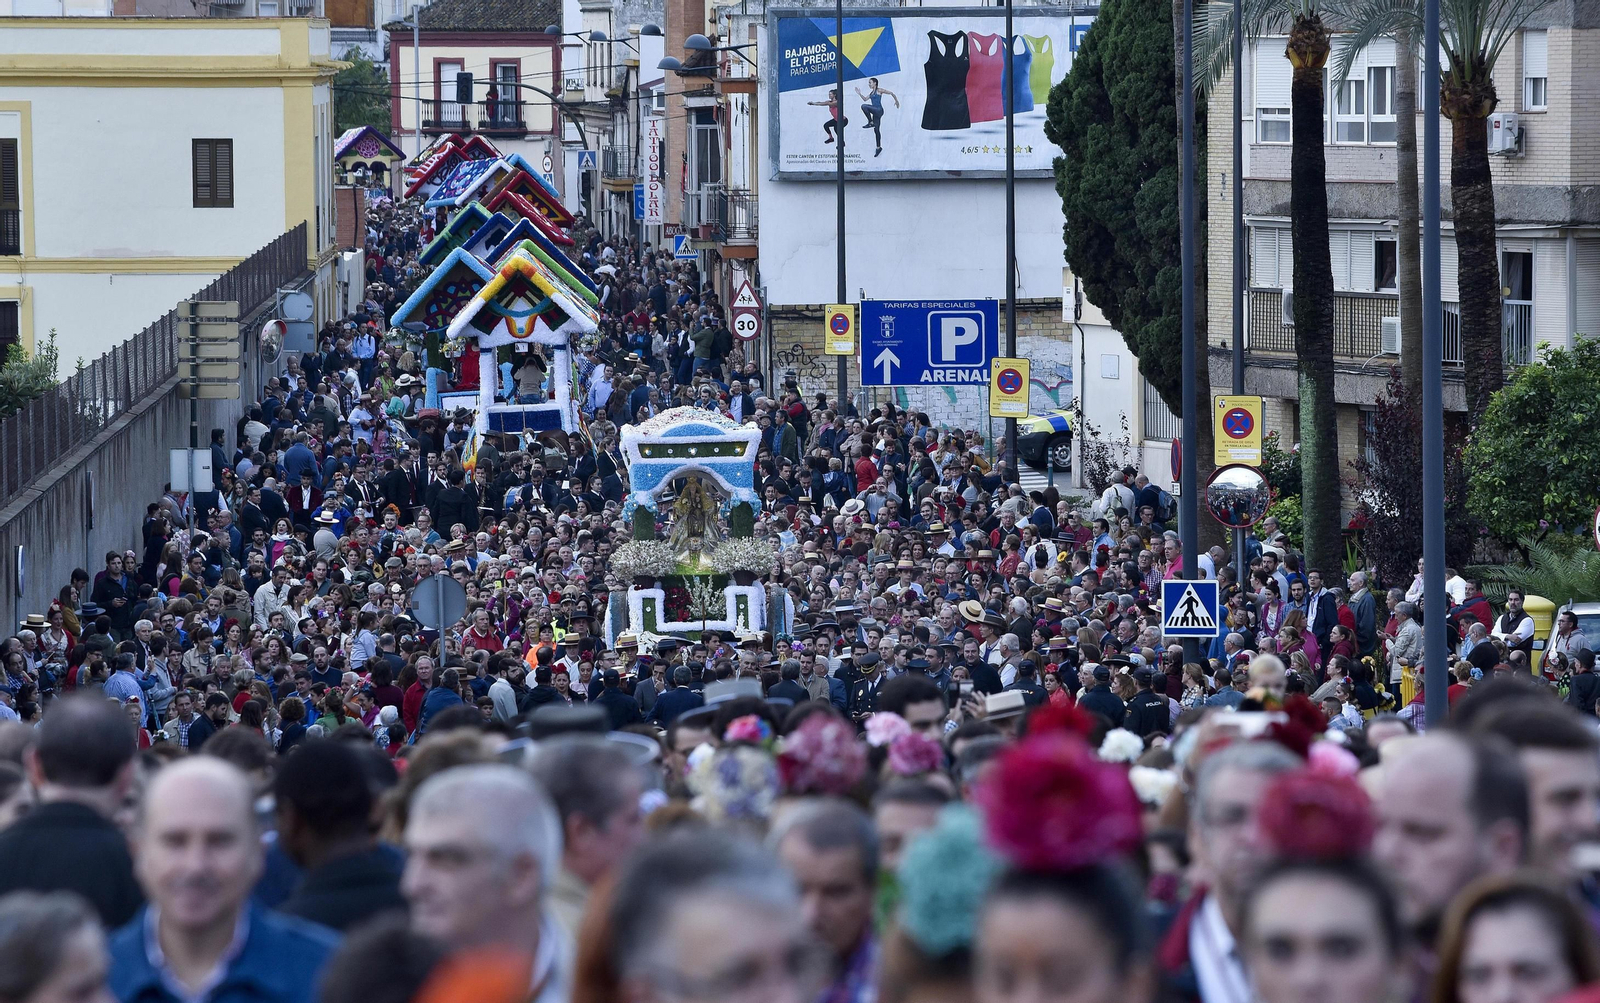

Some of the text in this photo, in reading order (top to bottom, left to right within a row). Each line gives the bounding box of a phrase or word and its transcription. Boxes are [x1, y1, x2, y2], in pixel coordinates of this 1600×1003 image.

[785, 43, 827, 59] BAJAMOS
[790, 51, 836, 68] EL PRECIO
[790, 61, 837, 77] PARA SIEMPR
[649, 120, 659, 170] TATTOO
[737, 320, 755, 331] 30
[941, 317, 979, 361] P
[920, 369, 991, 382] ARENAL
